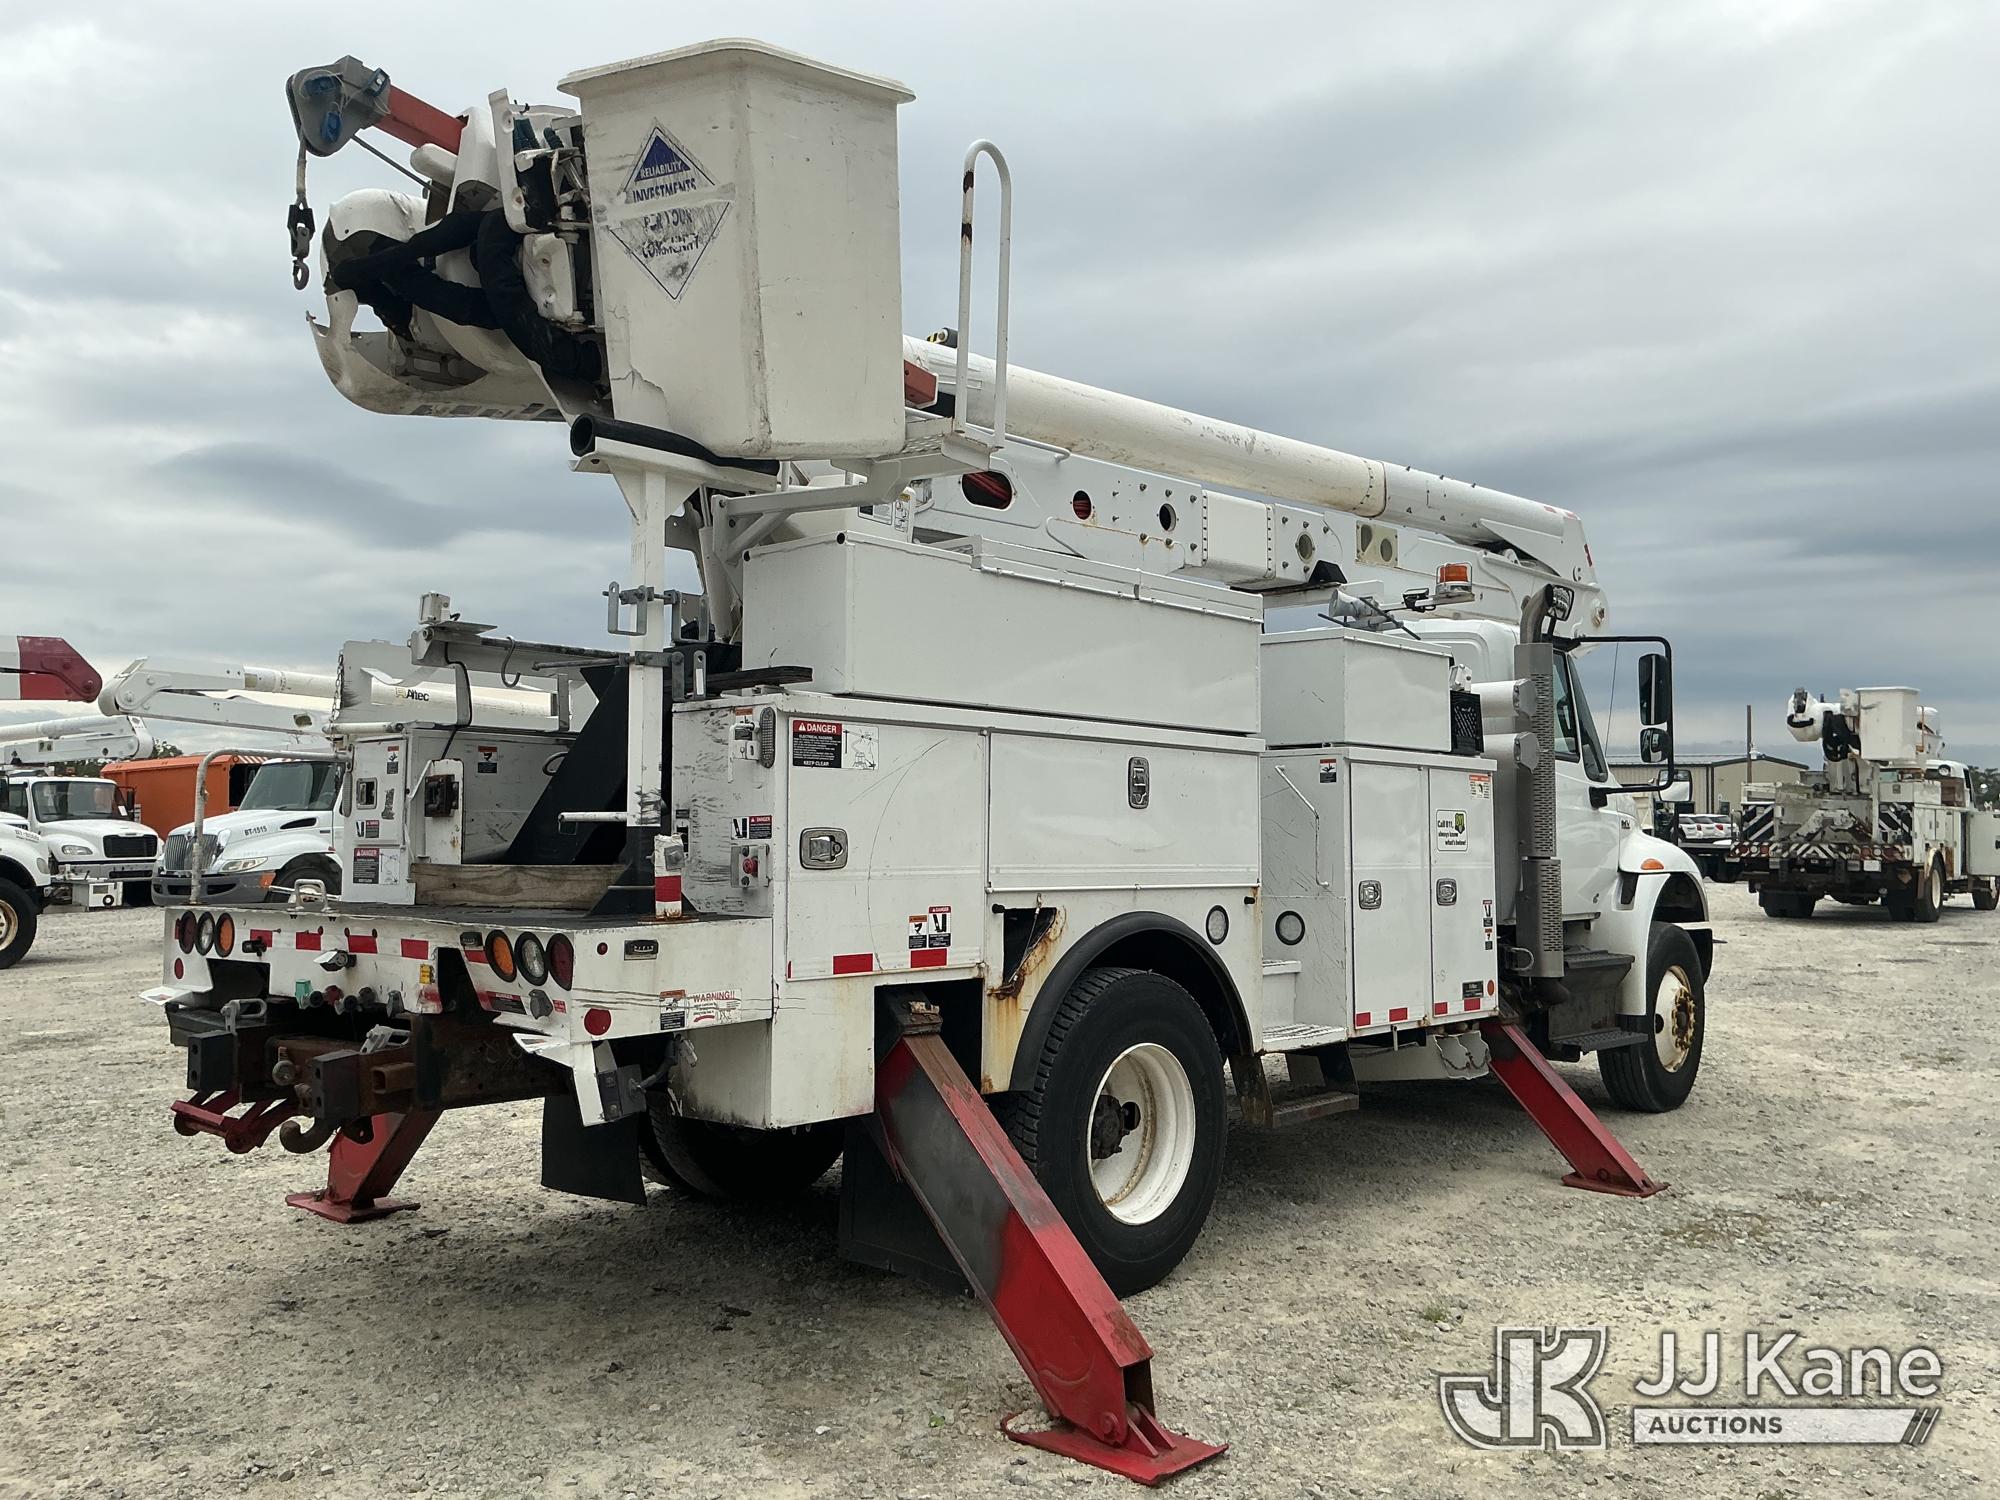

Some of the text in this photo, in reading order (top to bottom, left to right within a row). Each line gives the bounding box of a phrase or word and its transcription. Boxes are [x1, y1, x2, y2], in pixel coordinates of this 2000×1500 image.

[640, 161, 682, 179] RELIABILITY
[633, 178, 697, 203] INVESTMENTS
[406, 689, 430, 702] Altec
[806, 723, 837, 734] DANGER
[244, 825, 268, 836] BT-1515
[360, 849, 378, 857] DANGER
[693, 991, 735, 1003] WARNING!!
